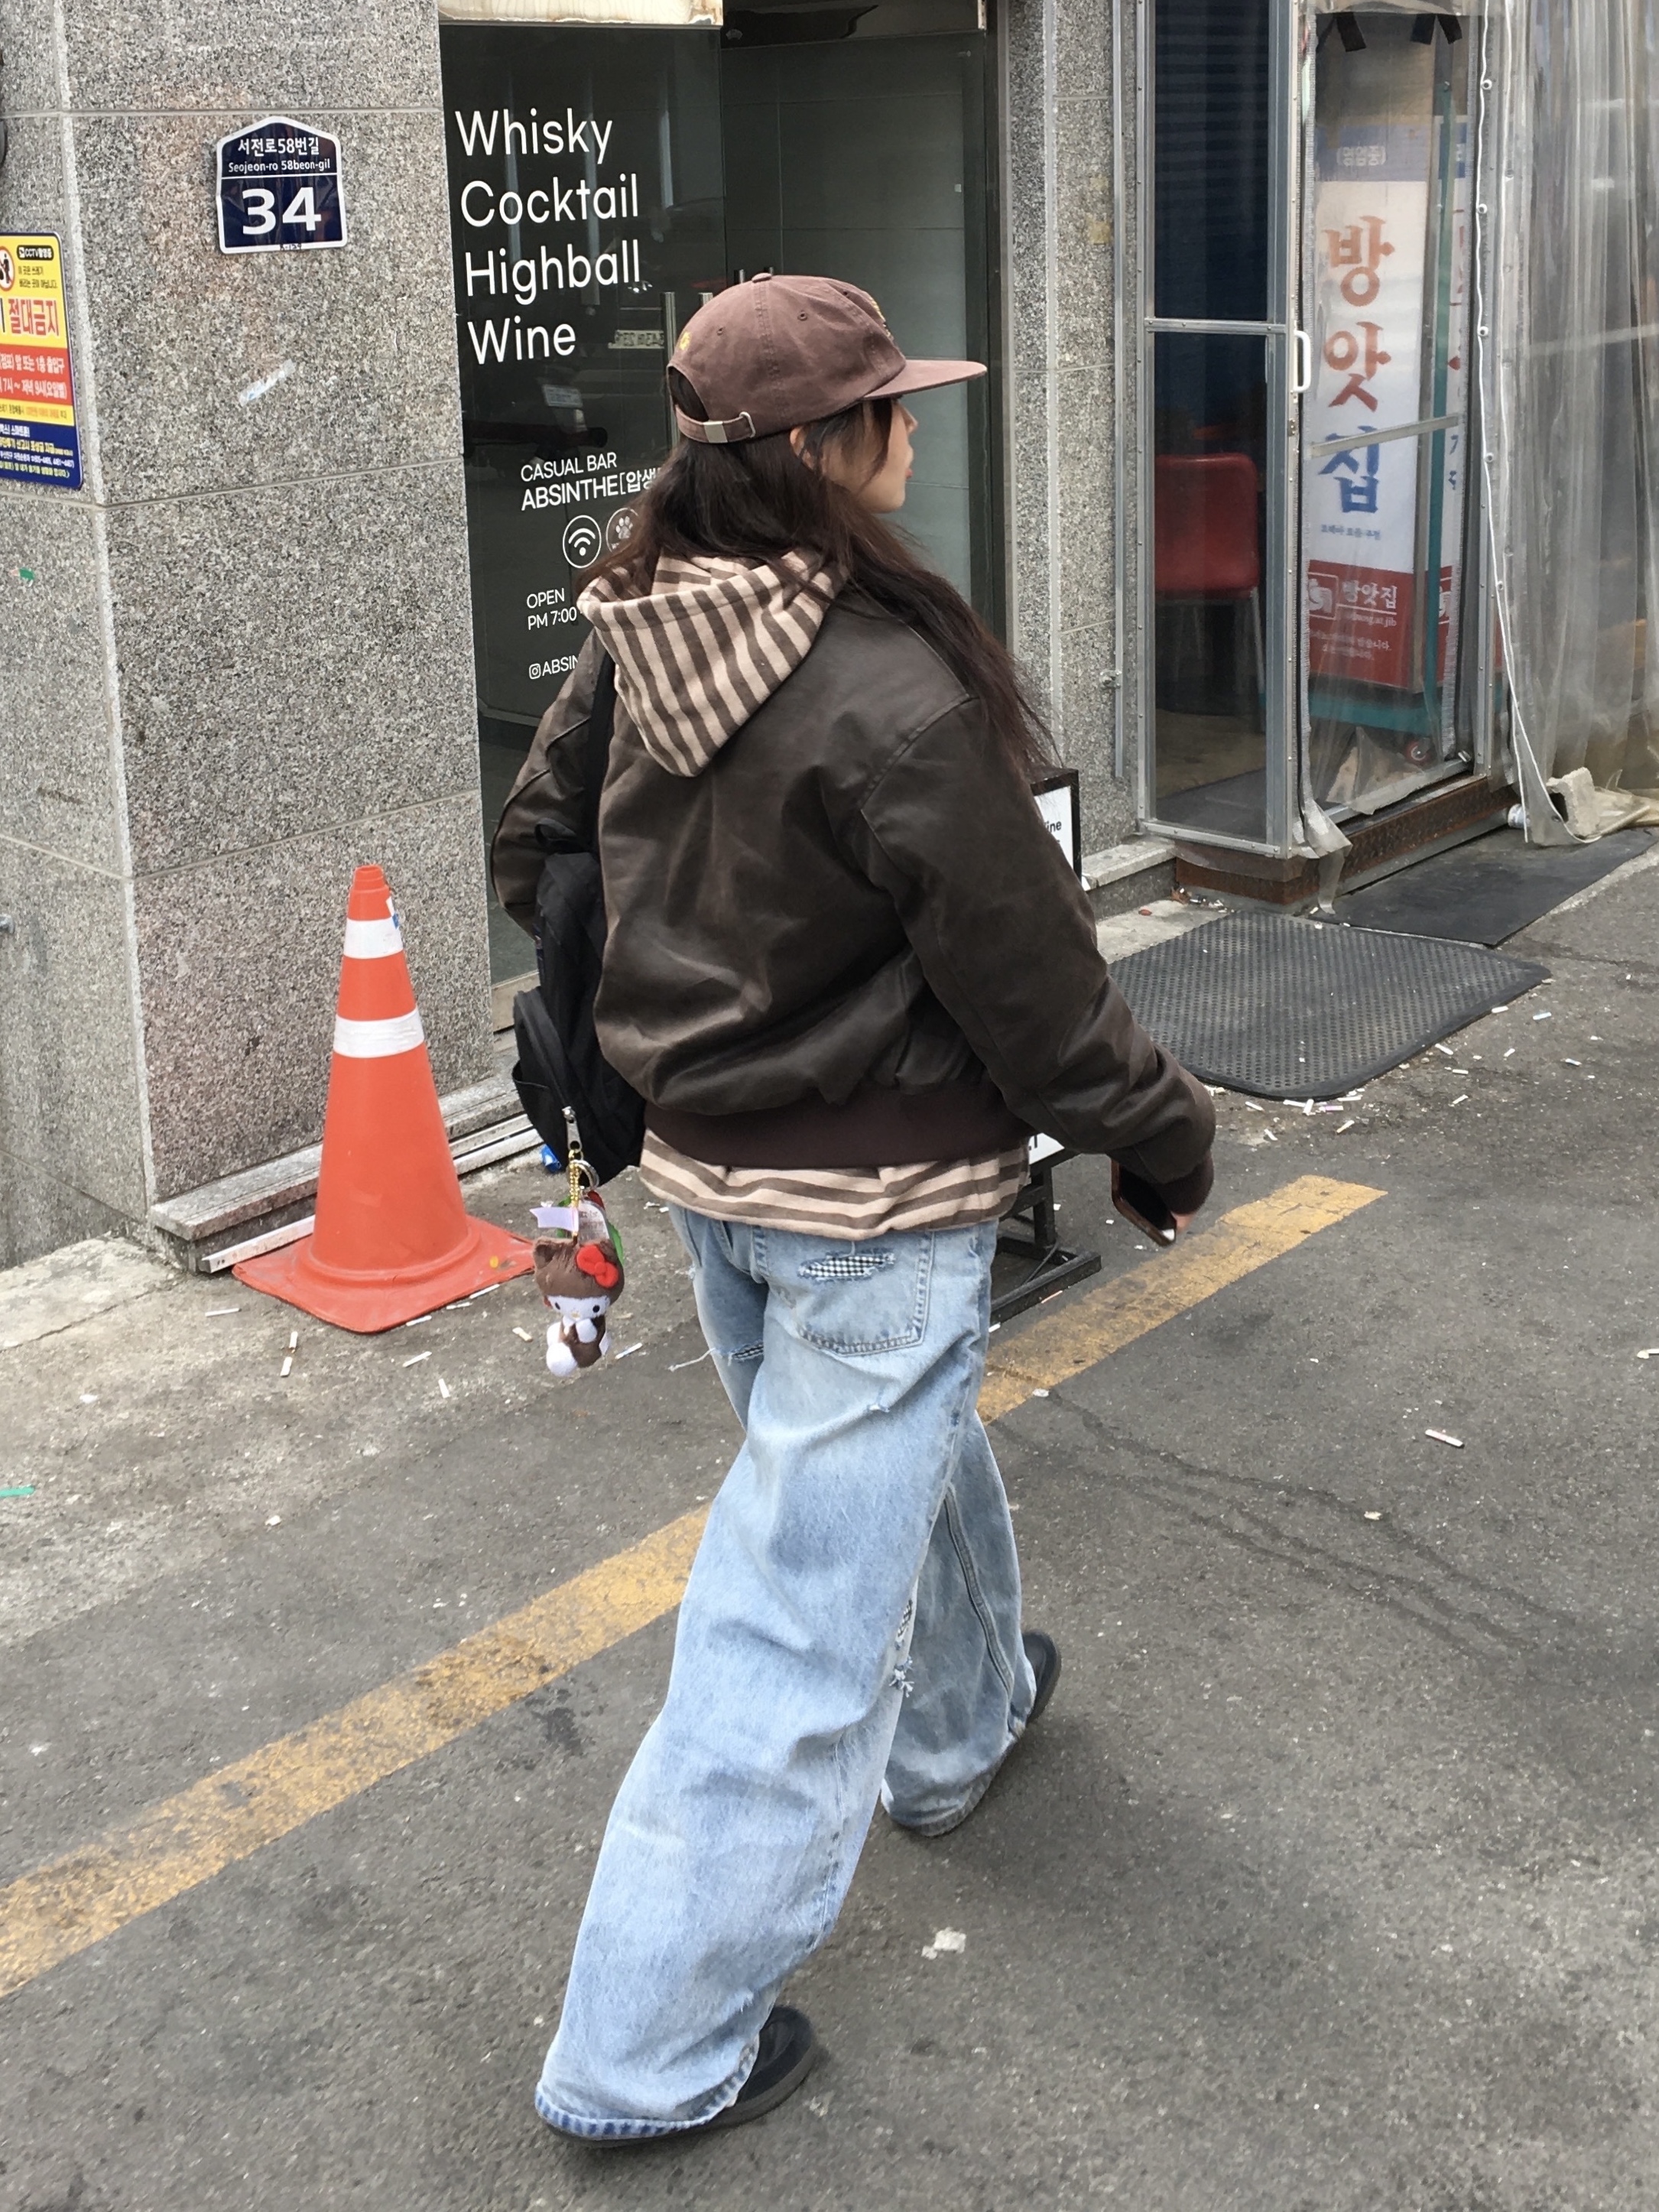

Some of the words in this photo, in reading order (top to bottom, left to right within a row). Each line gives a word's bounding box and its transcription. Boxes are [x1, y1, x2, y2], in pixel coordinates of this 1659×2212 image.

[238, 137, 320, 157] 서전로58번길
[455, 108, 612, 164] Whisky
[229, 162, 278, 175] Seojeon-ro
[281, 158, 330, 172] 58beon-gil
[242, 187, 322, 235] 34
[461, 174, 638, 227] Cocktail
[466, 239, 640, 305] Highball
[8, 298, 59, 336] 절대금지
[467, 316, 576, 365] Wine
[1318, 215, 1396, 514] 방앗집
[521, 457, 583, 482] CASUAL
[587, 452, 617, 471] BAR
[527, 587, 565, 609] OPEN
[528, 612, 548, 631] PM
[550, 606, 577, 625] 7:00
[1044, 820, 1062, 833] ine
